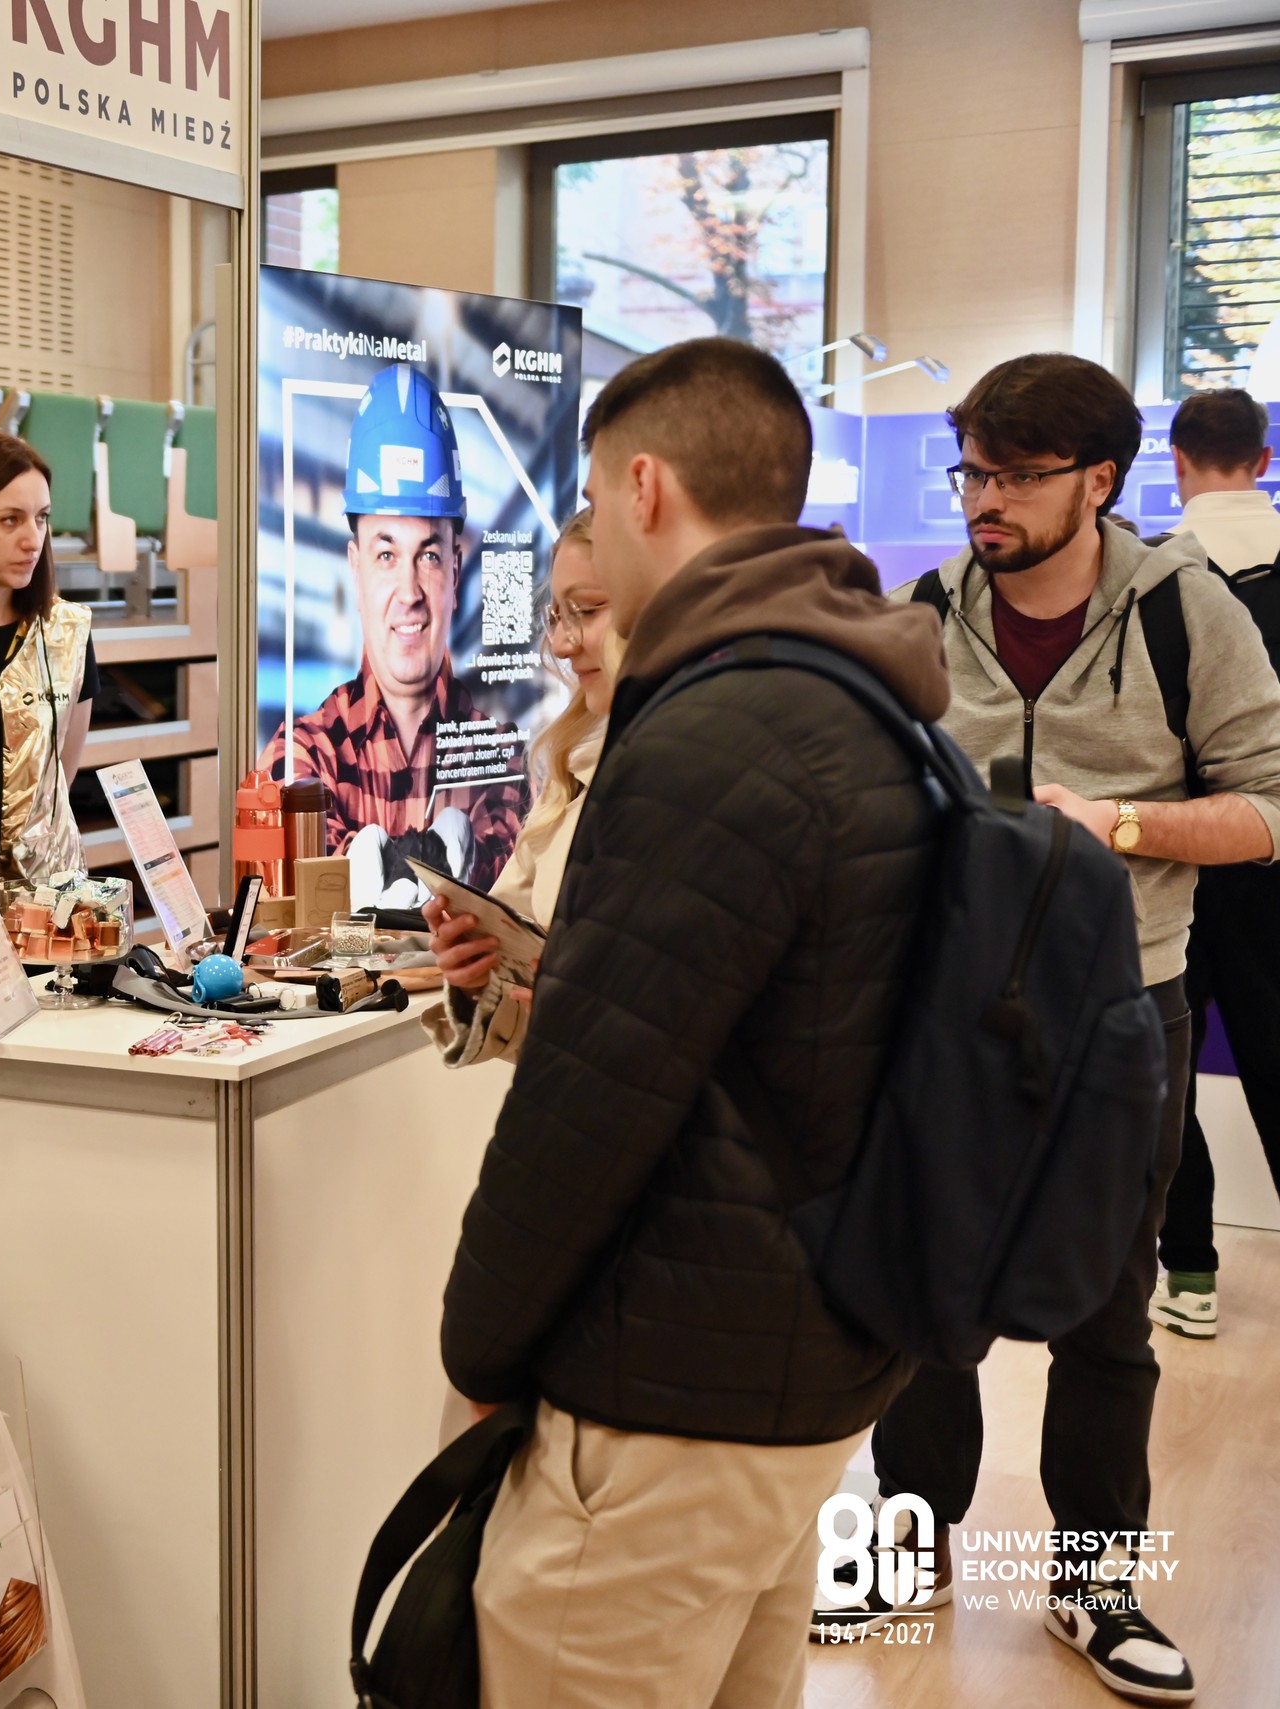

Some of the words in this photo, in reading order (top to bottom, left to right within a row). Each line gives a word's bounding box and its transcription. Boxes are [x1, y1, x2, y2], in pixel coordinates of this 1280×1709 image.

[12, 0, 231, 101] KGHM
[13, 71, 132, 127] POLSKA
[151, 107, 232, 150] MIEDŹ
[282, 325, 427, 362] #PraktykiNaMetal
[514, 349, 562, 374] KGHM
[482, 530, 516, 546] Zeskanuj
[476, 652, 511, 667] dowiedz
[511, 651, 522, 667] się
[481, 671, 488, 682] o
[488, 665, 533, 685] praktykach
[459, 716, 497, 734] pracownik
[435, 733, 473, 749] Zakładów
[436, 755, 441, 764] z
[436, 764, 485, 780] koncentratem
[485, 762, 507, 774] miedzi
